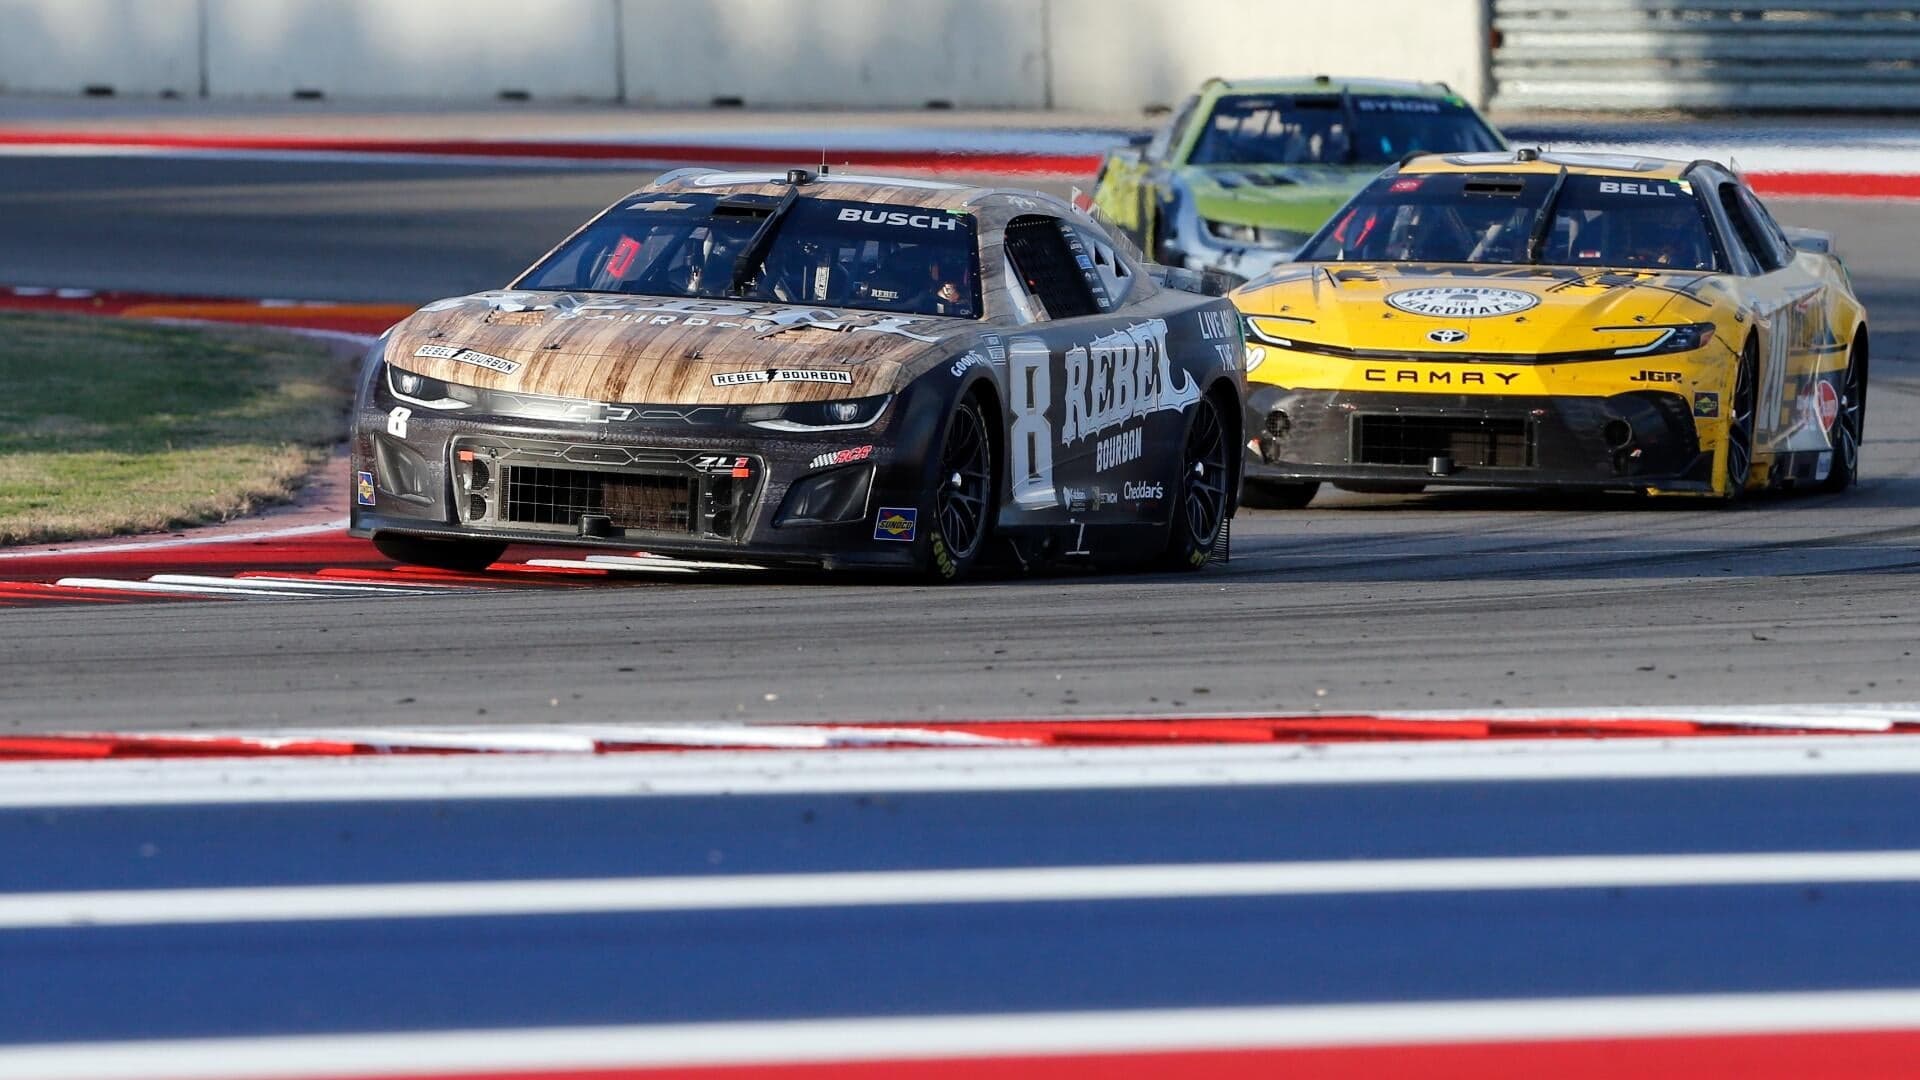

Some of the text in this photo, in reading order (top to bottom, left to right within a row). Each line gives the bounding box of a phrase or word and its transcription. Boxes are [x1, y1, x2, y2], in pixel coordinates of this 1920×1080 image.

[1599, 181, 1676, 197] BELL
[837, 208, 956, 231] BUSCH
[1401, 300, 1520, 314] HARDHATS
[1197, 311, 1225, 339] LIVE
[419, 346, 516, 372] REBEL BOURBON
[717, 371, 848, 383] REBEL BOURBON
[1062, 319, 1202, 447] REBEL
[1365, 369, 1521, 385] CAMRY
[1630, 370, 1682, 384] JGR
[387, 406, 412, 439] 8
[1008, 336, 1058, 510] 8
[1096, 427, 1142, 473] BOURBON
[1123, 481, 1164, 500] Cheddar's
[878, 520, 914, 531] SUNOCO
